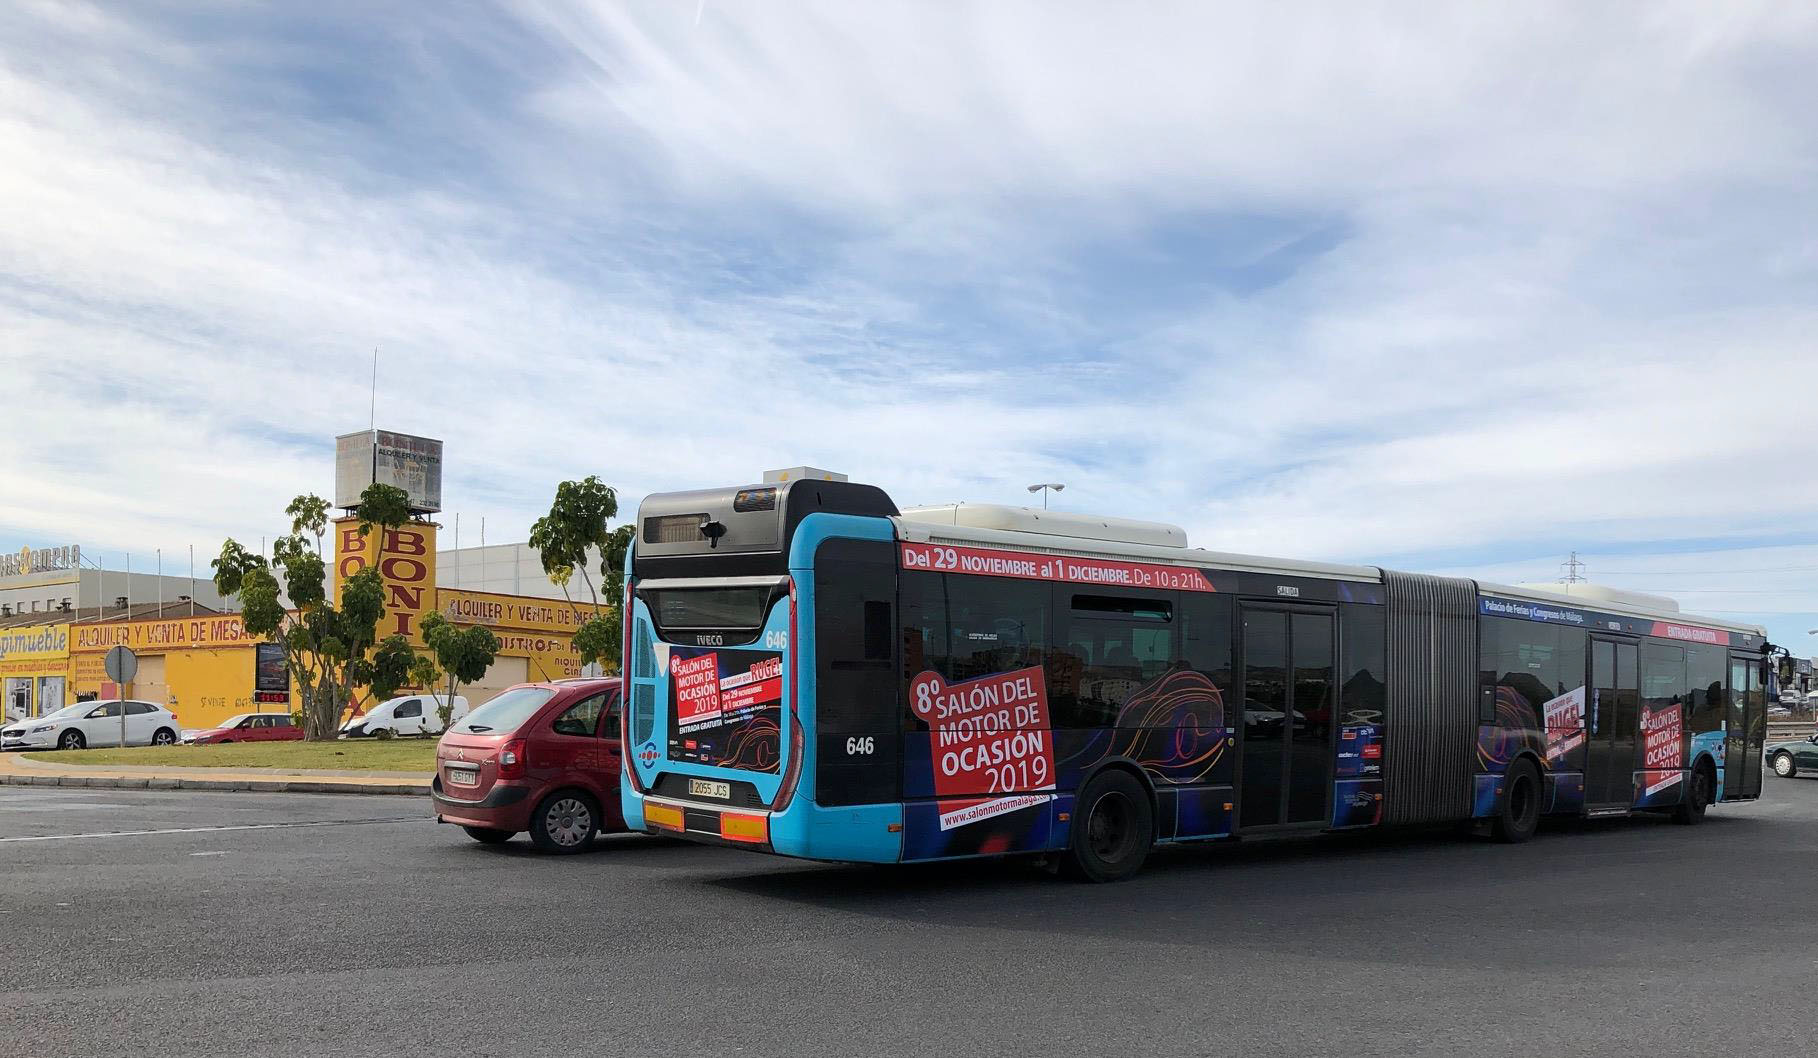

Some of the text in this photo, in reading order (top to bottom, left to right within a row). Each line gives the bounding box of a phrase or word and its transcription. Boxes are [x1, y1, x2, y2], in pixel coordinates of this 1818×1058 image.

[905, 547, 1206, 590] Del 29 NOVIEMBRE al 1 DICIEMBRE. De 10 a 21h.
[450, 599, 503, 619] ALQUILER
[507, 604, 514, 620] Y
[518, 605, 553, 623] VENTA
[557, 609, 570, 625] DE
[1485, 600, 1505, 612] Palacio
[1506, 603, 1513, 613] de
[1513, 604, 1529, 615] Ferias
[1529, 608, 1533, 618] y
[1533, 607, 1559, 620] Congresos
[1560, 611, 1566, 620] de
[0, 628, 66, 658] pimueble
[78, 626, 130, 647] ALQUILER
[135, 625, 142, 644] Y
[146, 623, 185, 644] VENTA
[190, 622, 206, 642] DE
[696, 634, 723, 645] IVECO
[766, 630, 788, 649] 646
[1667, 626, 1716, 642] ENTRADA GRATUITA
[555, 657, 581, 667] ALQUIL
[678, 661, 699, 675] SALÓN
[701, 658, 714, 670] DEL
[750, 656, 780, 681] RUGE!
[678, 670, 715, 688] MOTOR DE
[680, 681, 716, 701] OCASIÓN
[722, 691, 730, 700] Del
[730, 689, 738, 698] 29
[916, 677, 1037, 720] 8º SALÓN DEL
[694, 695, 718, 714] 2019
[728, 700, 732, 708] 1
[679, 719, 723, 734] ENTRADA GRATUITA
[939, 702, 1040, 748] MOTOR DE
[1647, 714, 1668, 733] SALÓN
[1668, 710, 1679, 724] DEL
[846, 736, 874, 755] 646
[1647, 724, 1680, 748] MOTOR DE
[941, 731, 1043, 776] OCASIÓN
[1647, 740, 1680, 765] OCASIÓN
[985, 755, 1047, 793] 2019
[1660, 755, 1680, 779] 2019
[694, 781, 727, 796] 2055 JCS
[945, 794, 1050, 826] www.salonmotormalaga.co
